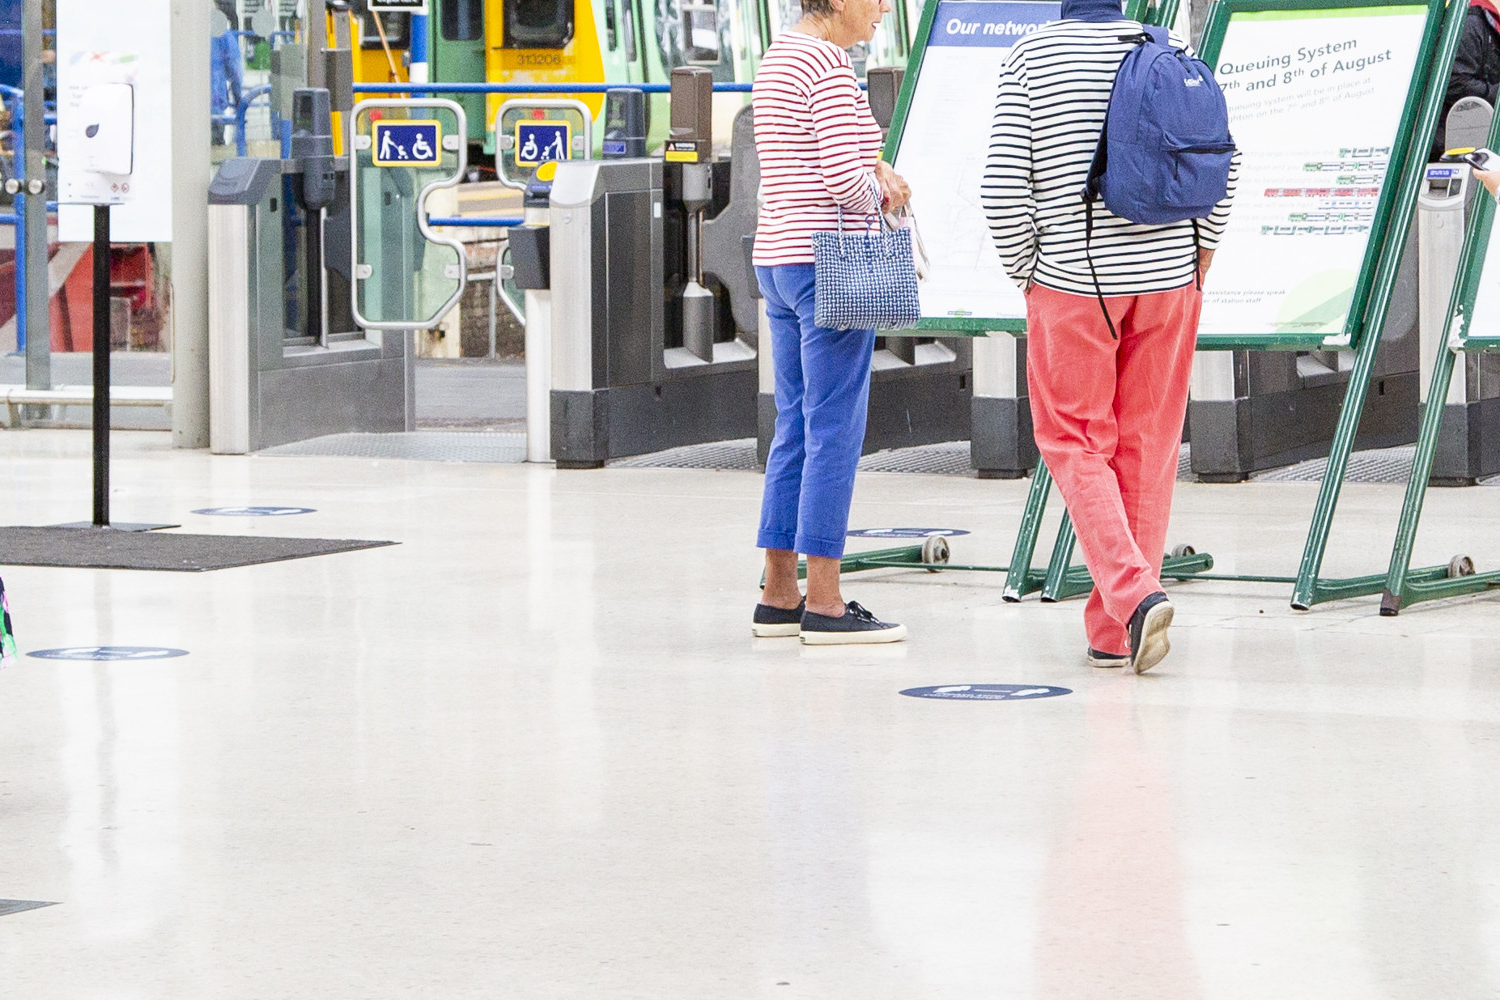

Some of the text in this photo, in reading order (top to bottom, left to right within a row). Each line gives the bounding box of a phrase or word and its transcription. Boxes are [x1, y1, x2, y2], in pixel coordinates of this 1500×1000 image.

[946, 19, 1050, 35] Our networ
[1220, 39, 1357, 76] Queuing System
[1246, 74, 1276, 92] and
[1283, 67, 1305, 84] 8th
[1310, 62, 1328, 78] of
[1332, 49, 1392, 74] August
